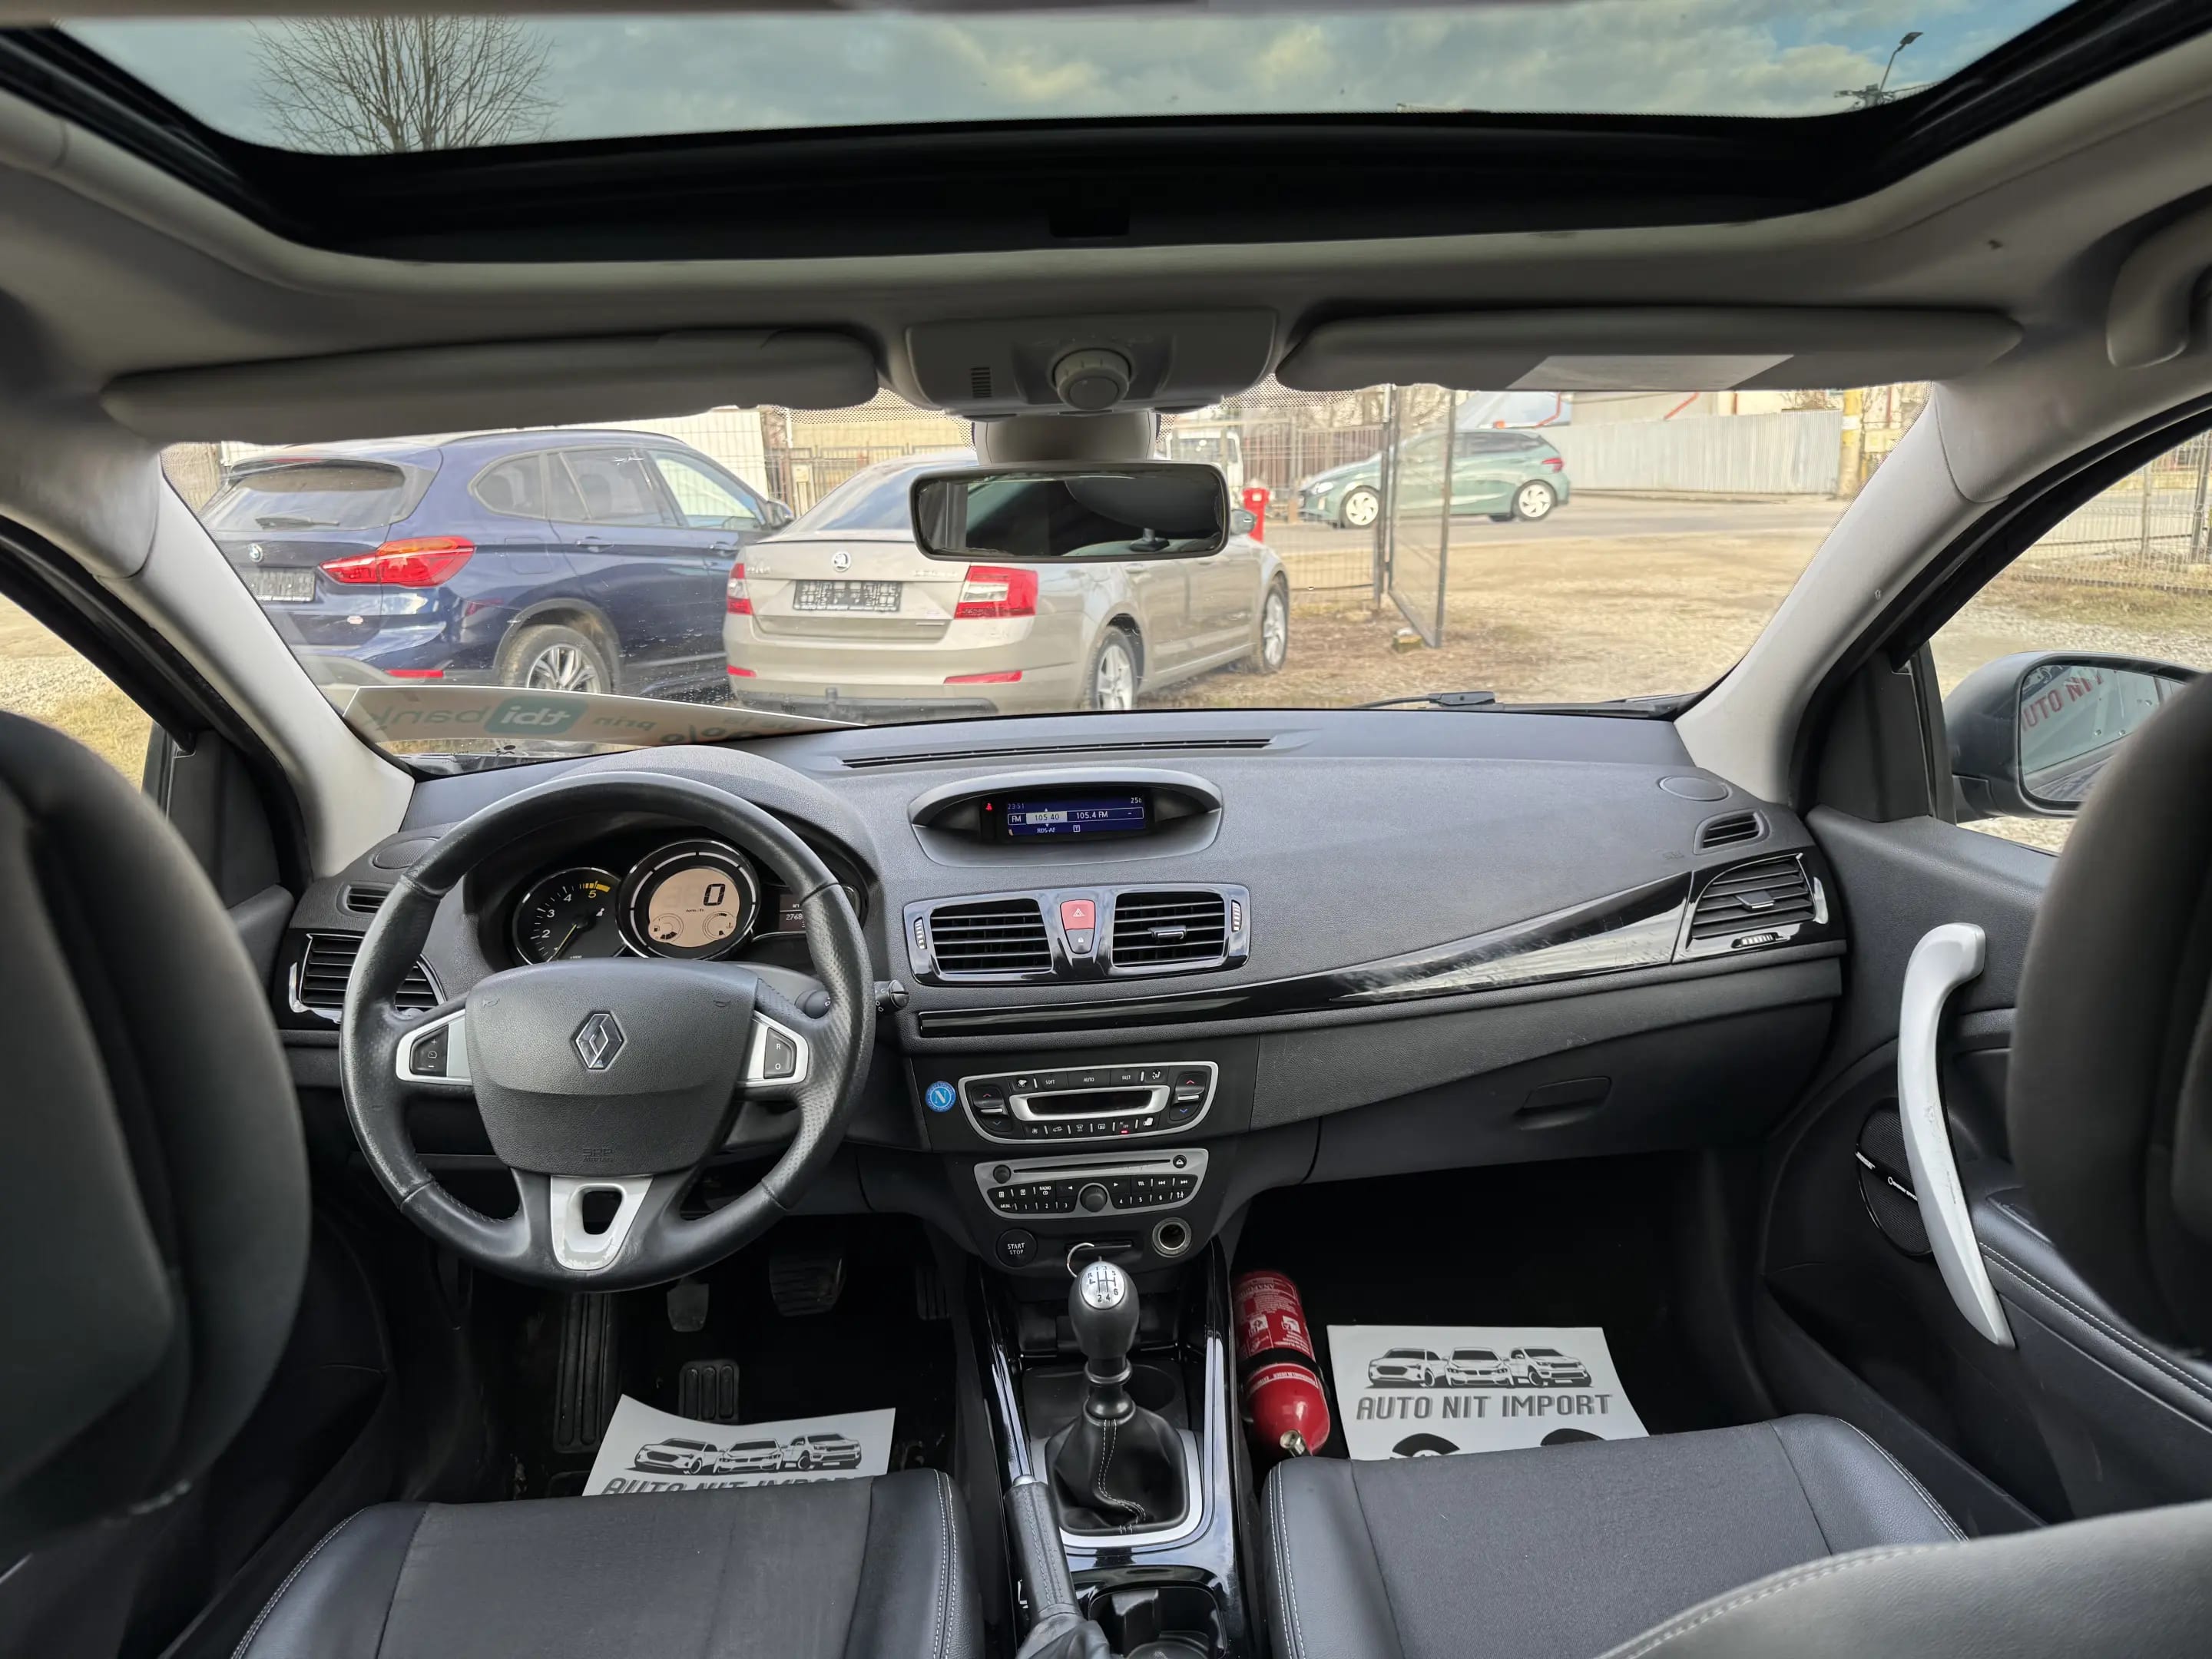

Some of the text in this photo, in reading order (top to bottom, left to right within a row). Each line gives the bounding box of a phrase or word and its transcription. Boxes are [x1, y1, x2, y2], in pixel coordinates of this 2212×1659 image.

[1012, 814, 1022, 823] FM
[1076, 810, 1097, 820] 105.4
[563, 893, 572, 902] 4
[588, 889, 598, 899] 5
[703, 883, 726, 906] 0
[546, 909, 555, 918] 3
[541, 929, 551, 939] 2
[934, 1090, 946, 1104] N
[1097, 1294, 1102, 1303] 2
[1105, 1293, 1111, 1302] 4
[1356, 1394, 1613, 1420] AUTO NIT IMPORT
